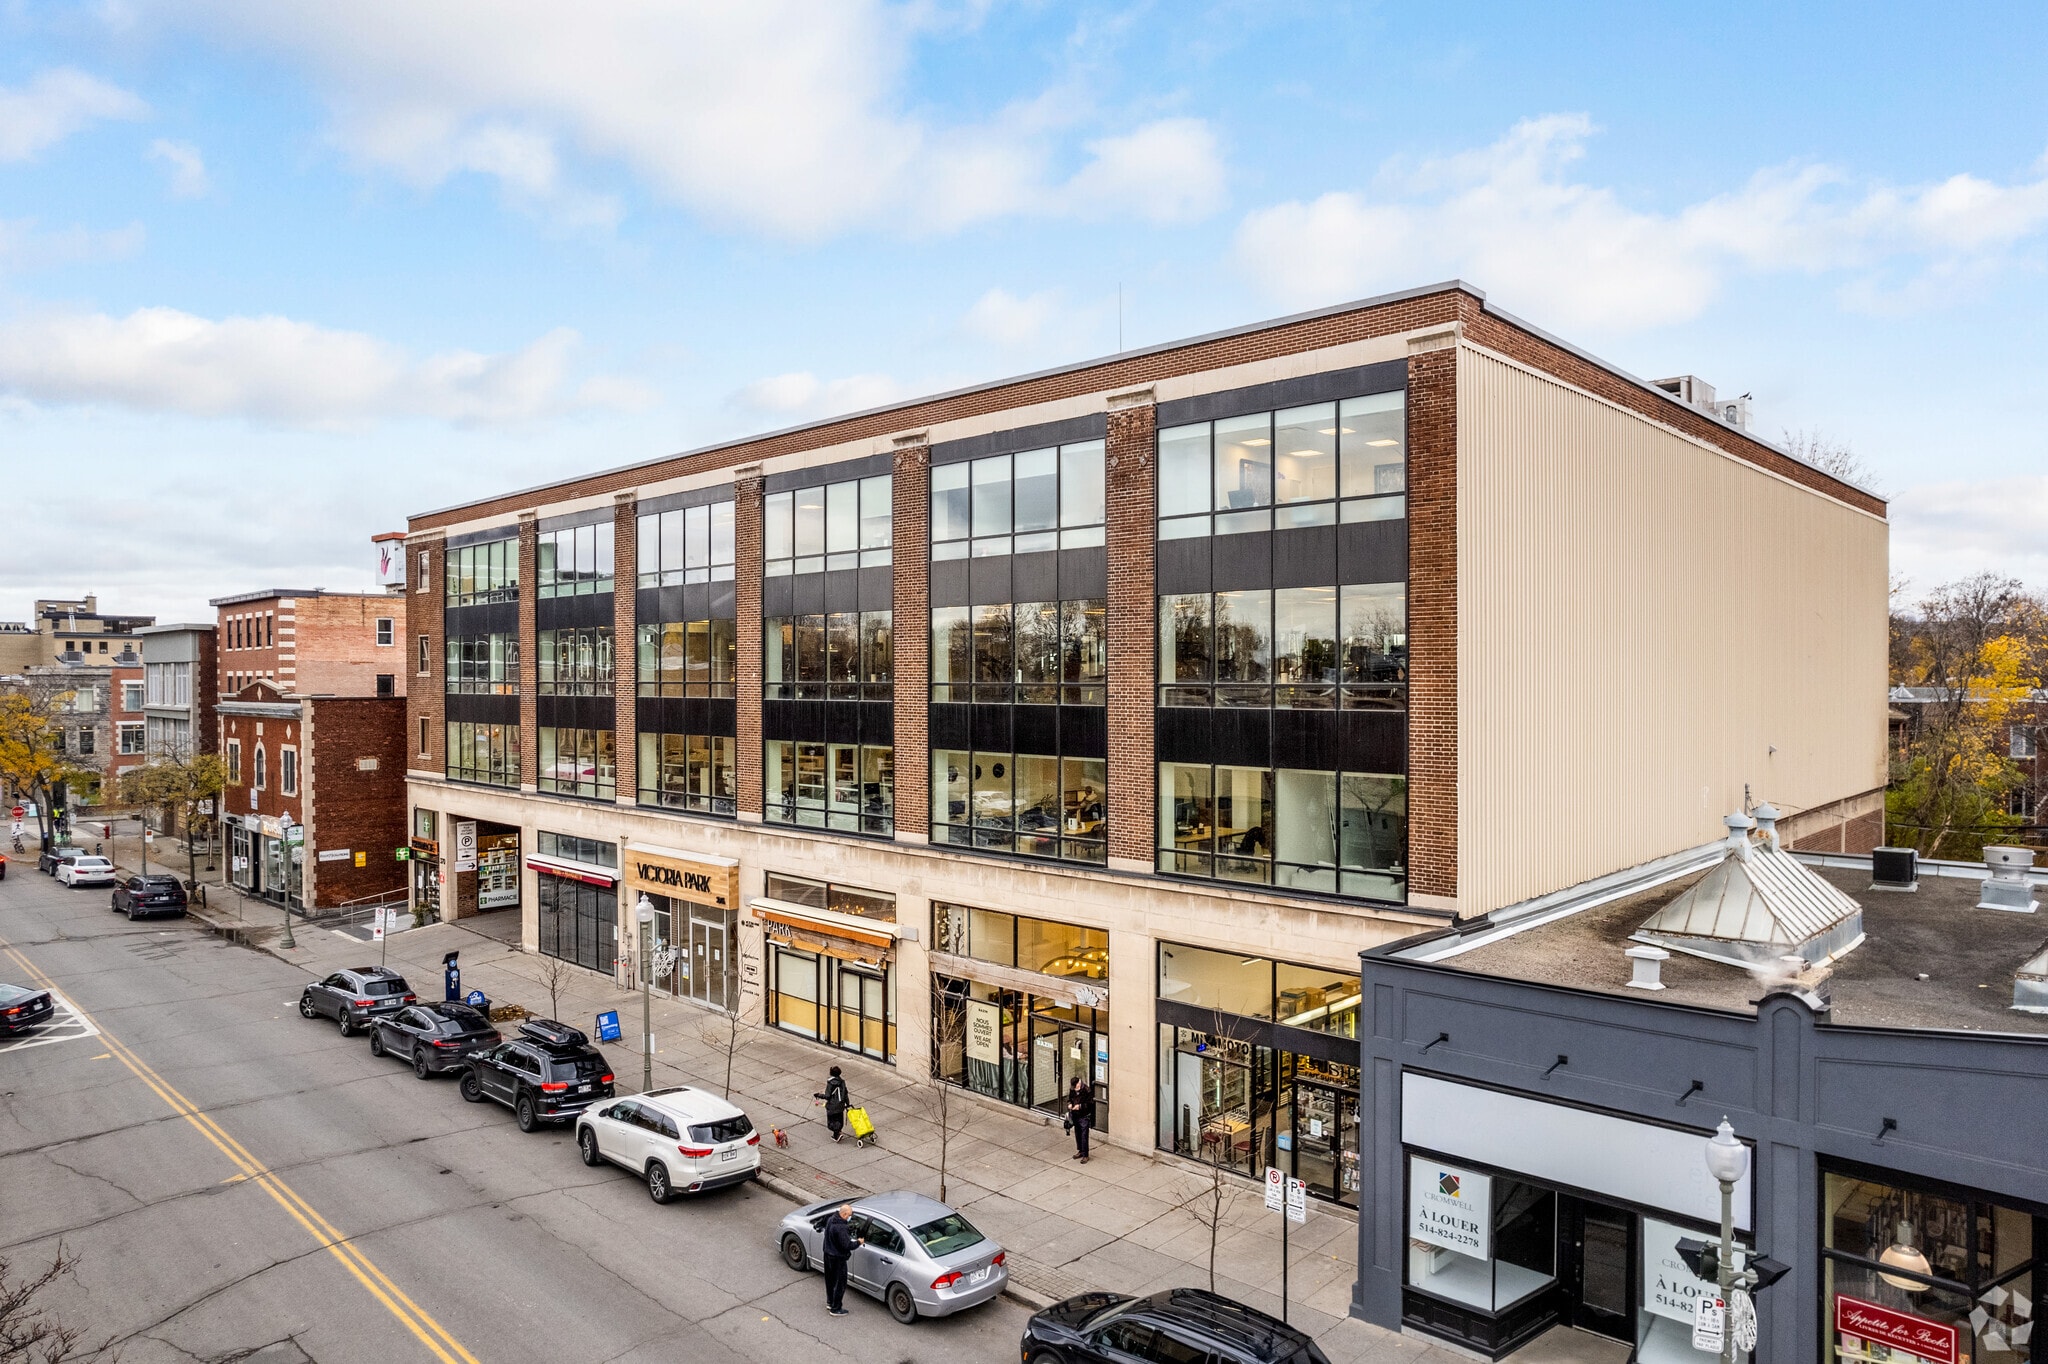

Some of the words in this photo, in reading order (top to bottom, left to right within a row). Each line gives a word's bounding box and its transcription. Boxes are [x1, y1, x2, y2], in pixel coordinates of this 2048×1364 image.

[636, 862, 684, 887] VICTORIA
[684, 872, 712, 893] PARK
[488, 895, 517, 903] PHARMACIE
[767, 920, 792, 937] PARK
[973, 1022, 992, 1032] SOMMES
[976, 1018, 989, 1026] NOUS
[973, 1028, 992, 1036] OUVERT
[982, 1036, 991, 1044] ARE
[1424, 1191, 1474, 1212] CROMWELL
[1419, 1205, 1428, 1219] À
[1432, 1211, 1479, 1234] LOUER
[1419, 1222, 1479, 1248] 514-824-2278
[1656, 1274, 1666, 1290] À
[1656, 1294, 1694, 1313] 514-82
[1842, 1310, 1889, 1330] Appetite
[1891, 1324, 1909, 1336] for
[1912, 1328, 1950, 1349] Books
[1858, 1324, 1879, 1334] LIVRES
[1887, 1332, 1916, 1346] RECETTES
